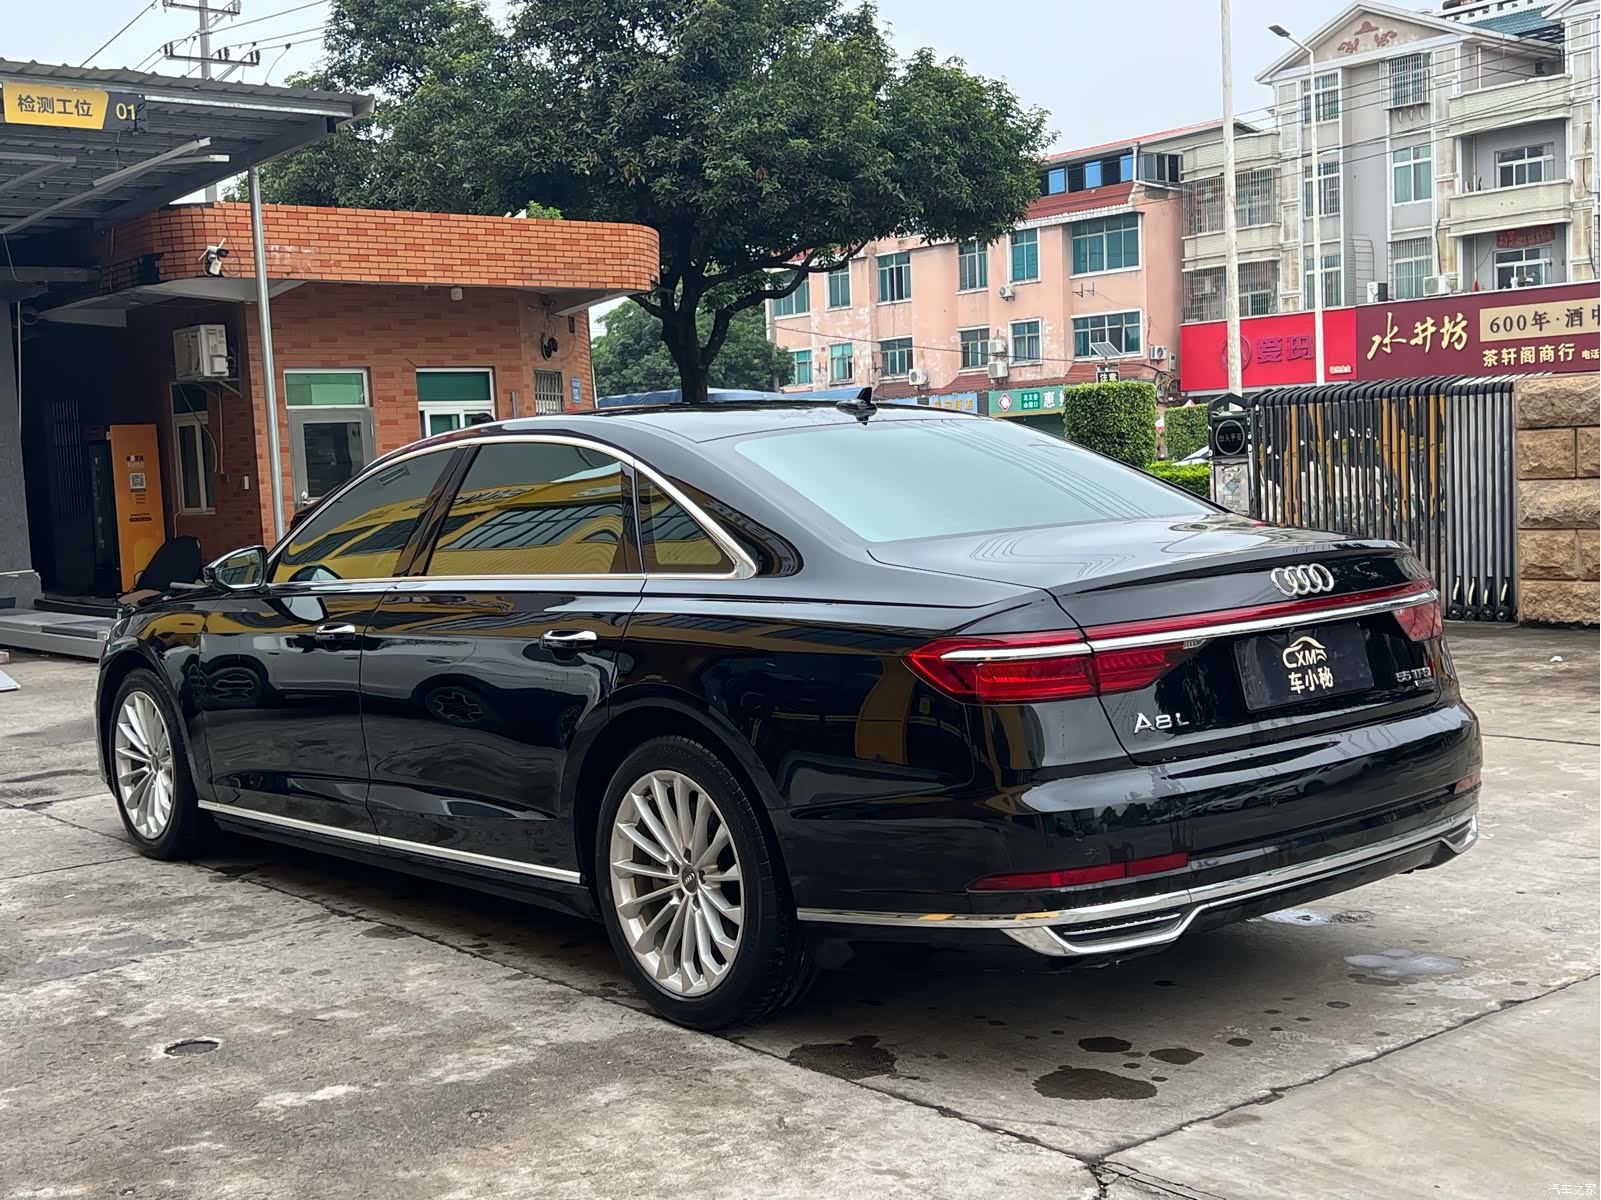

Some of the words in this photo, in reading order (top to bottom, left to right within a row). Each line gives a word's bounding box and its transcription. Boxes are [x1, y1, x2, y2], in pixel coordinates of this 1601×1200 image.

[17, 94, 94, 117] 检测工位
[116, 102, 137, 120] 01
[1366, 311, 1468, 361] 水井坊
[1257, 335, 1314, 364] 爱玛
[1482, 342, 1575, 367] 茶轩阁商行
[1288, 666, 1333, 694] 车小秘
[1394, 670, 1411, 683] 55
